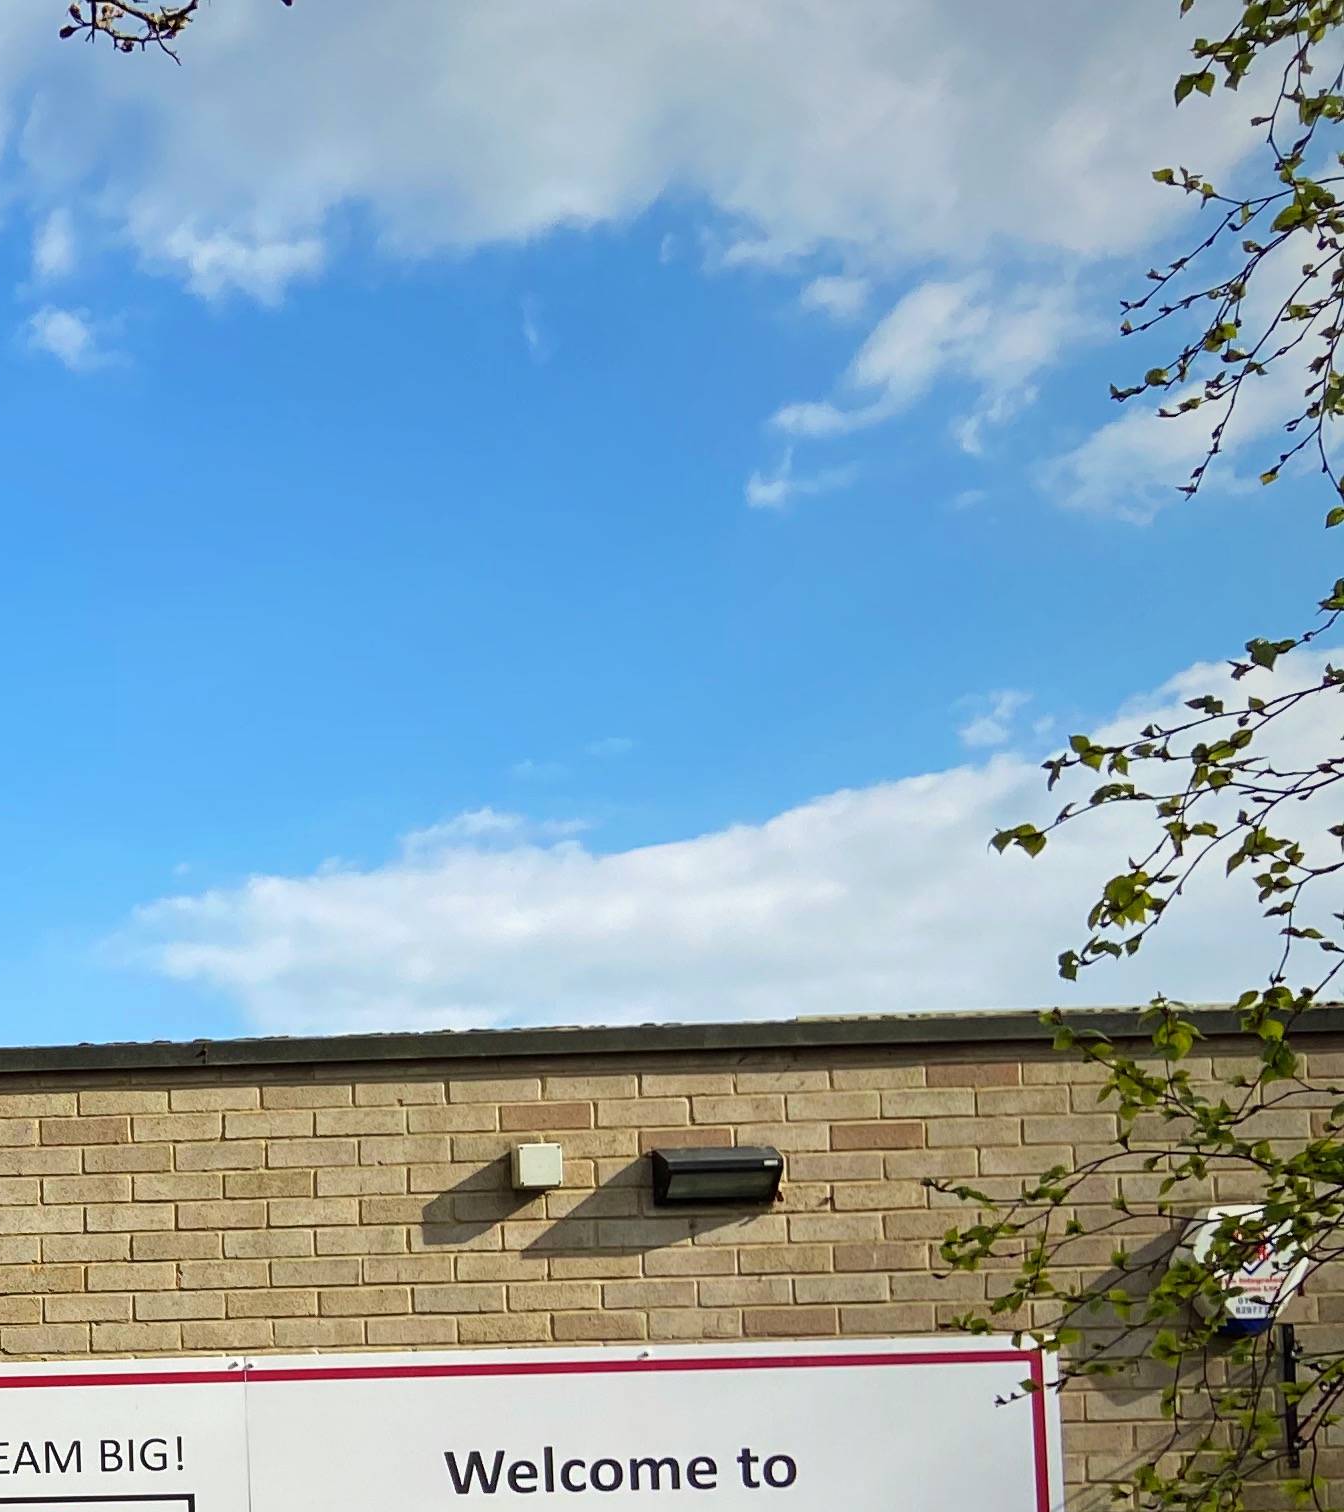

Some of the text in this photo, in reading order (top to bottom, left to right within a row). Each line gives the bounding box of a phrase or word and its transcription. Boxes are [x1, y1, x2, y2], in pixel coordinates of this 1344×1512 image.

[100, 1435, 185, 1473] BIG!
[443, 1445, 797, 1495] Welcome to
